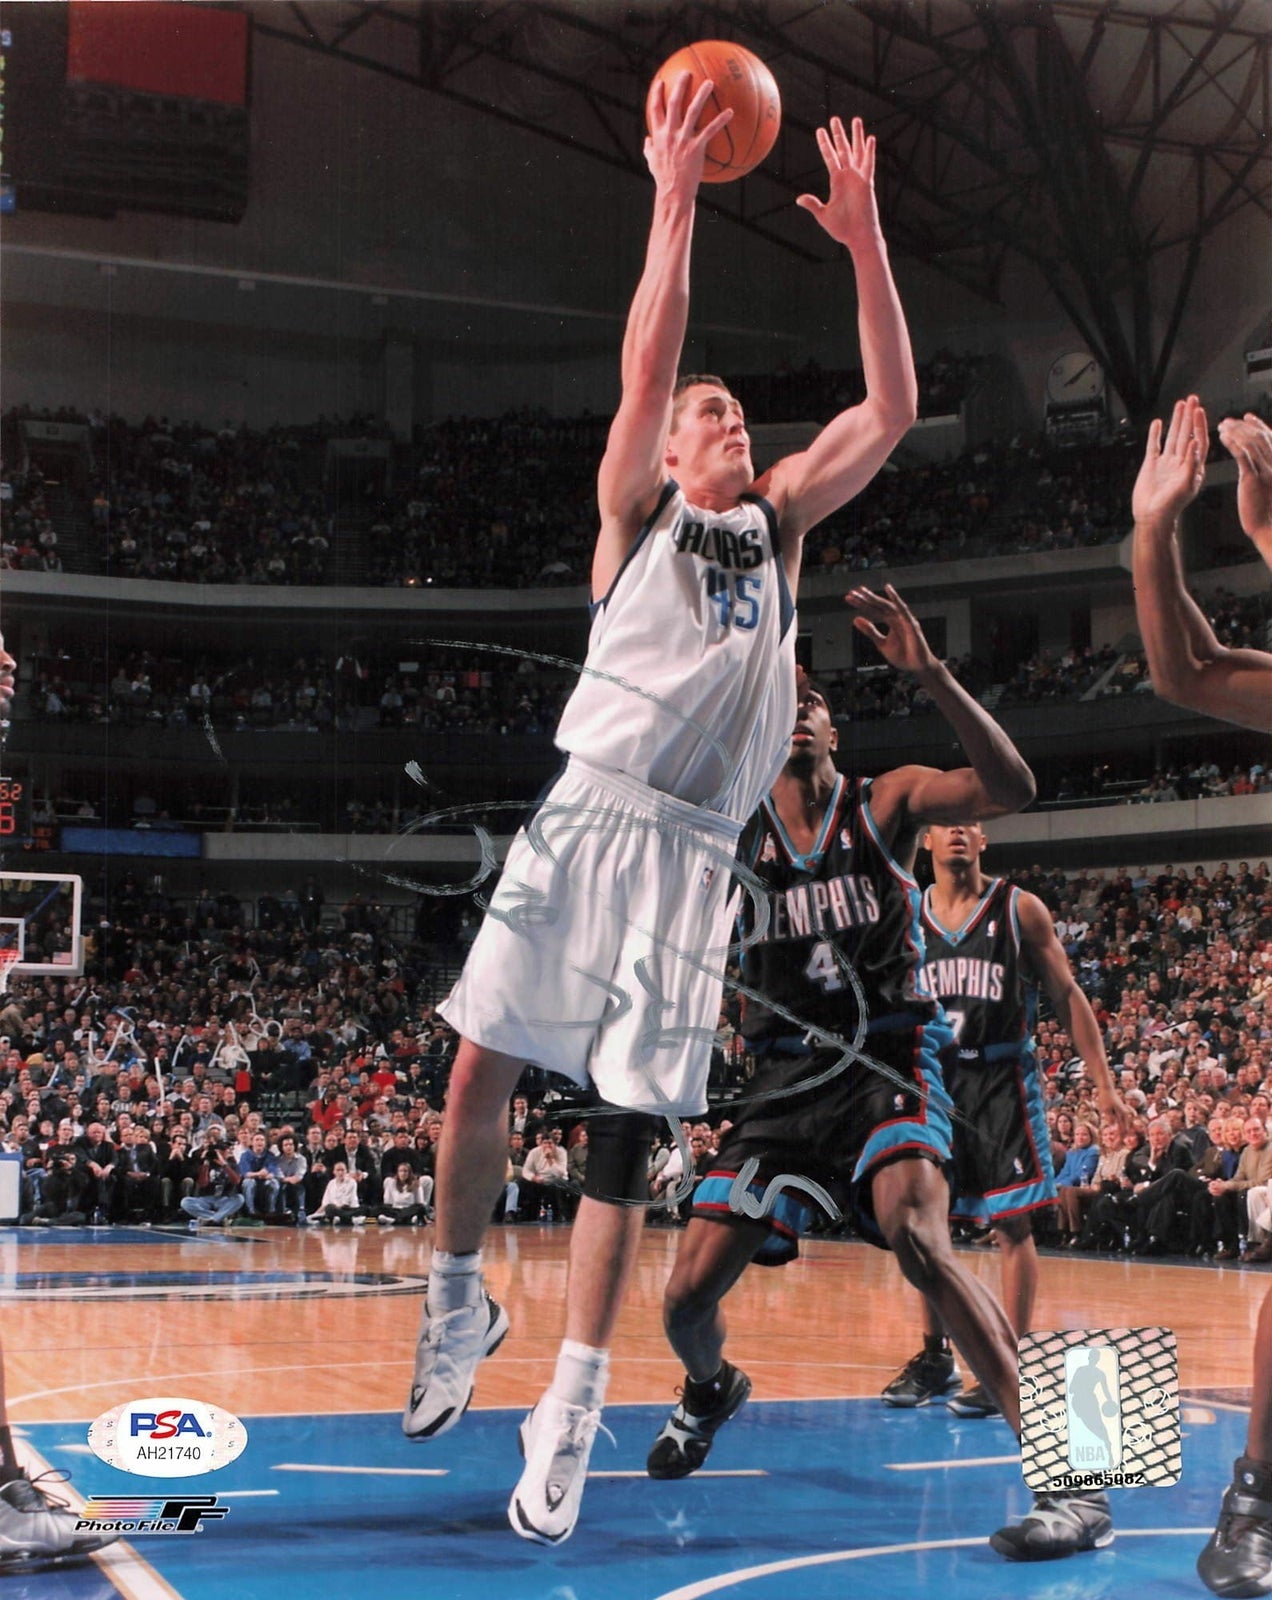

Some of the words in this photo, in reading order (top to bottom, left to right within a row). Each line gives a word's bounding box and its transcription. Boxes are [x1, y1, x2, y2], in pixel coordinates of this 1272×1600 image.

[706, 566, 762, 630] 45
[757, 873, 880, 943] EMPHIS
[805, 941, 846, 992] 4
